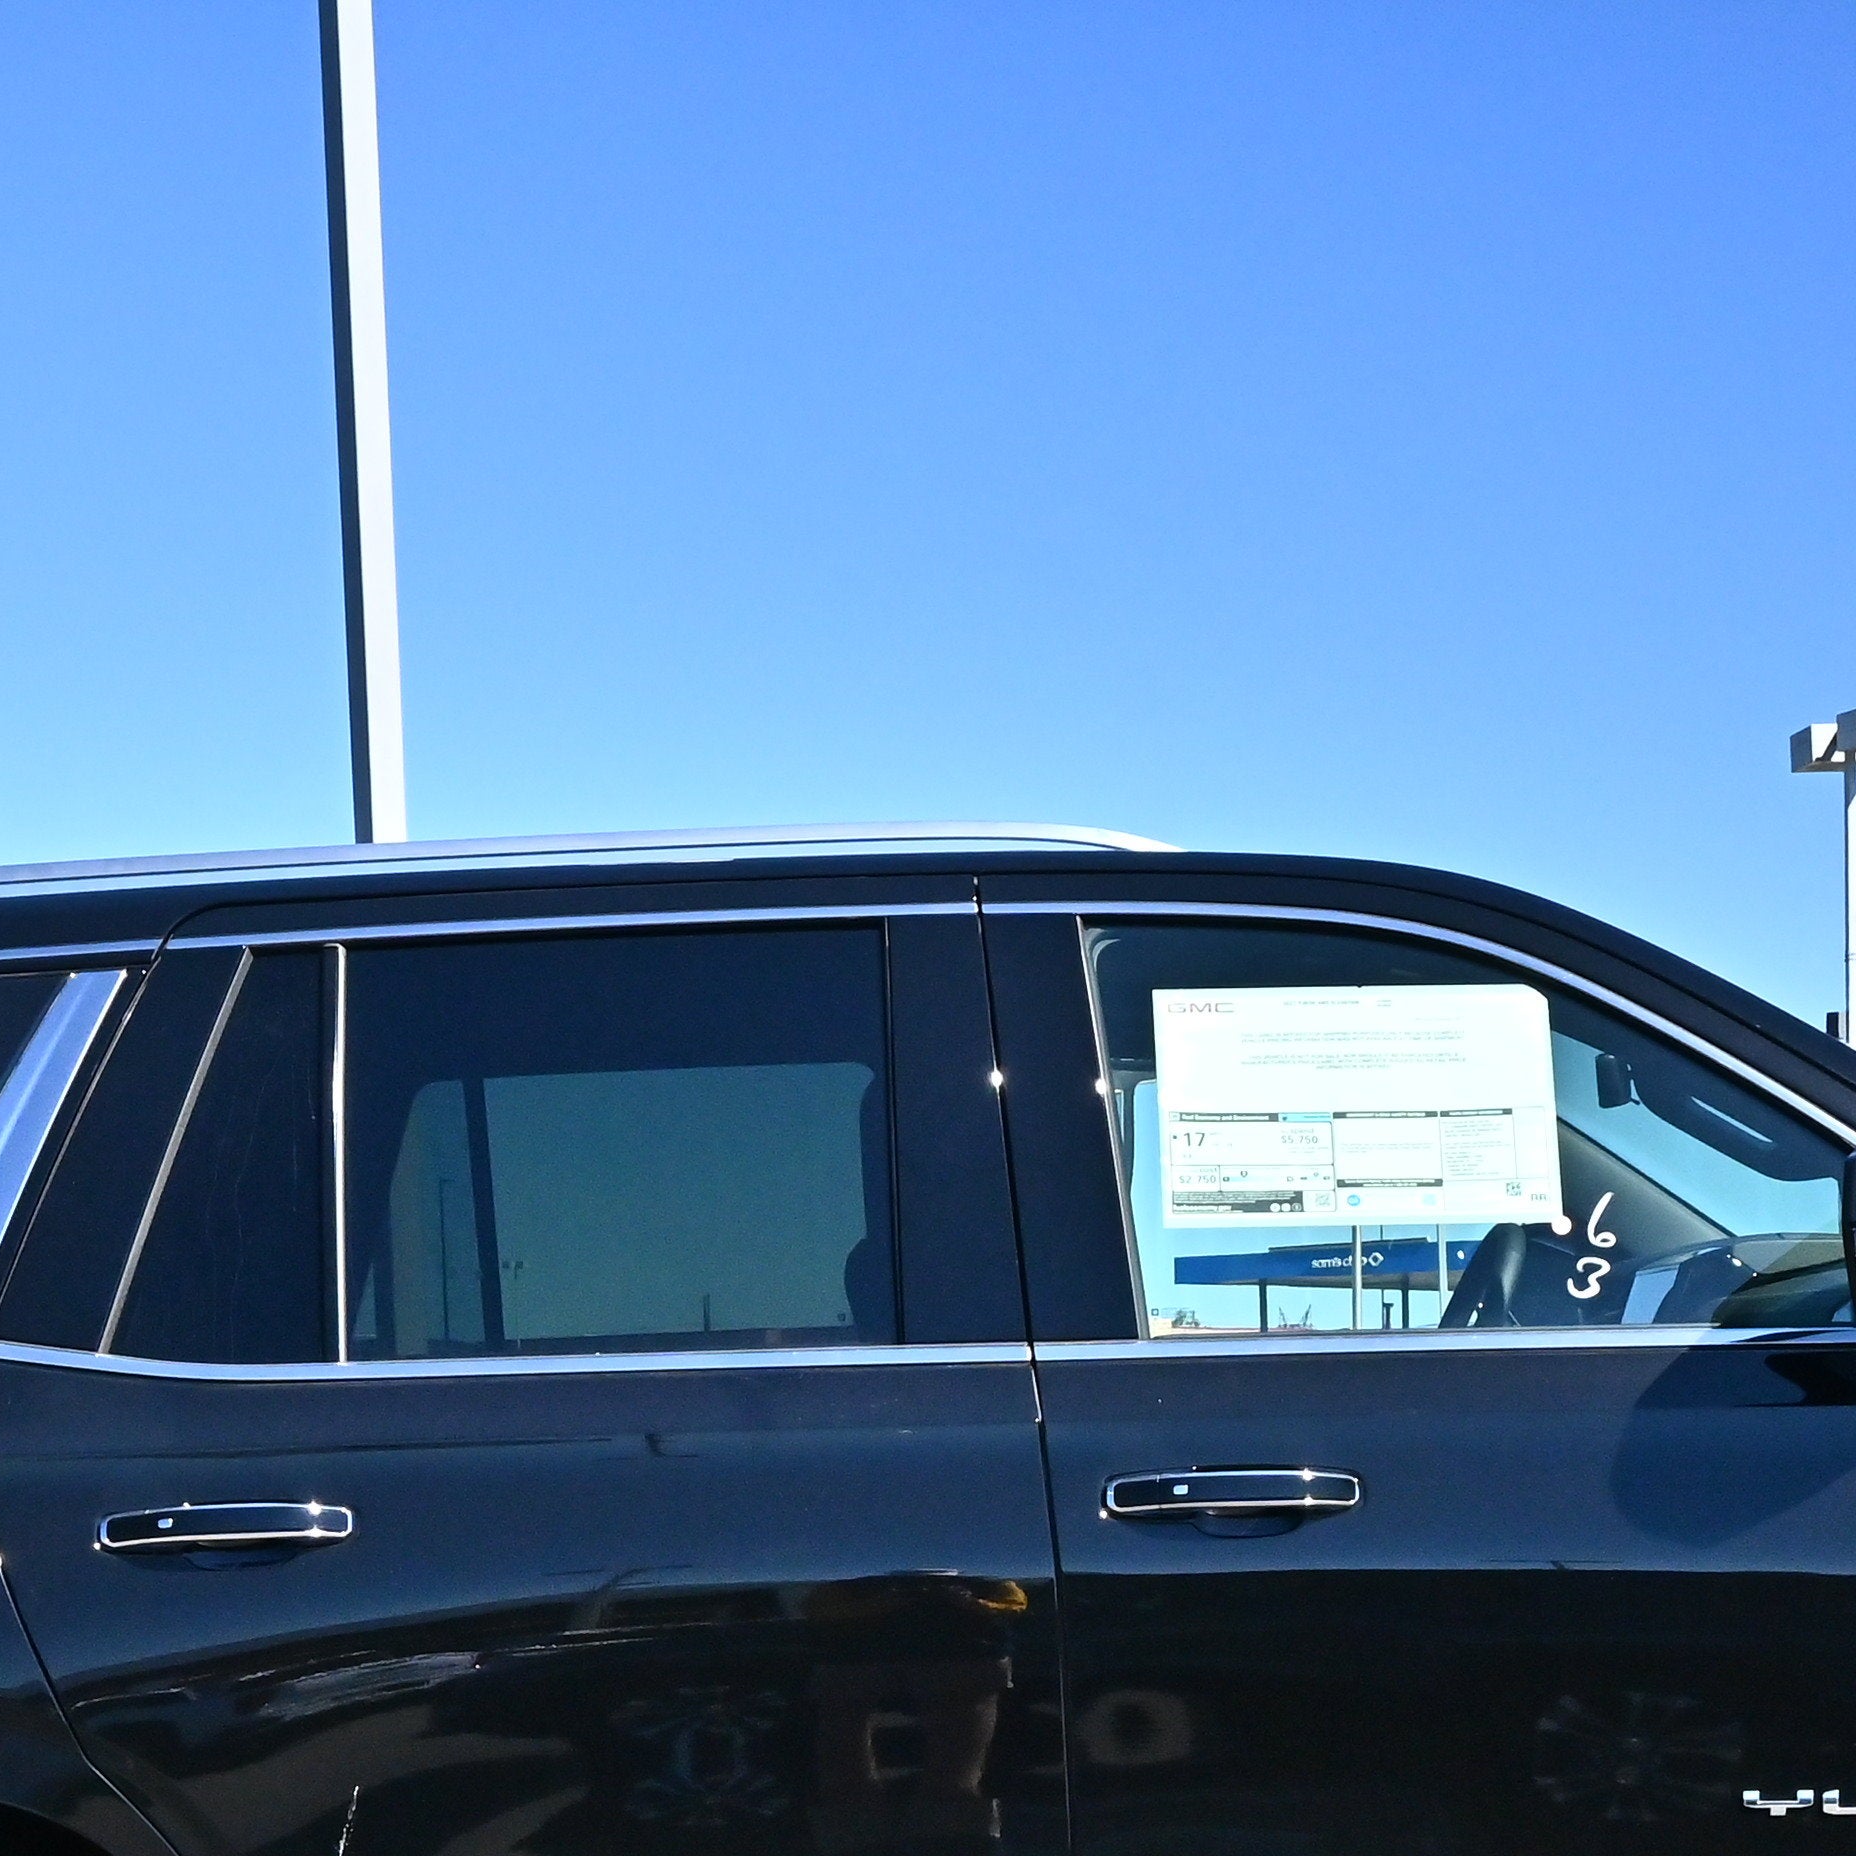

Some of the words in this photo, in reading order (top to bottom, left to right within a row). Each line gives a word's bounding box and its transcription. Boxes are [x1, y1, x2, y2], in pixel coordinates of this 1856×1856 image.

[1167, 1002, 1235, 1014] GMC
[1183, 1132, 1206, 1147] 17
[1587, 1191, 1617, 1248] 6
[1567, 1256, 1611, 1299] 3
